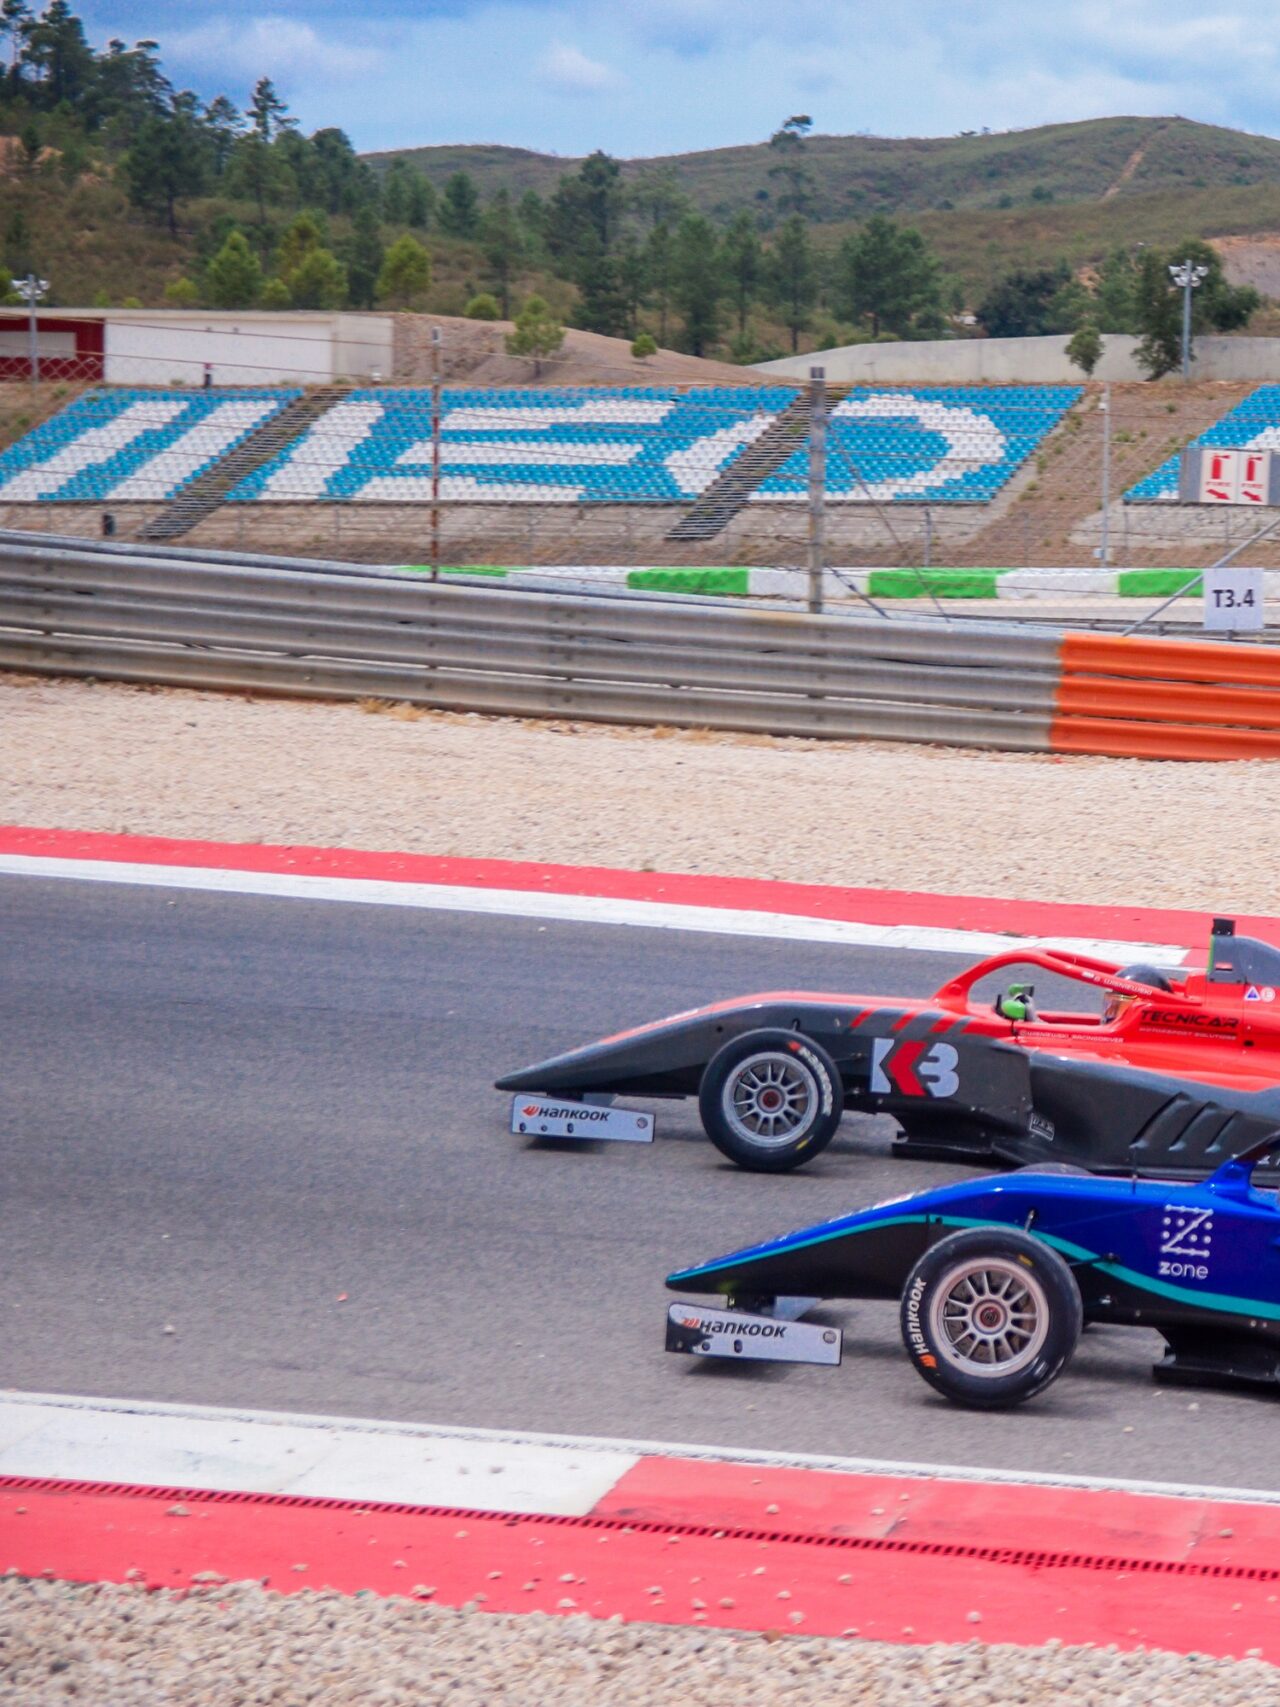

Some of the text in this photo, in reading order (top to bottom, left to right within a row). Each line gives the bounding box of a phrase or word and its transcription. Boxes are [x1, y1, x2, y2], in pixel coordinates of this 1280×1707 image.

[1212, 589, 1255, 608] T3.4
[1141, 1010, 1240, 1028] TECNICAR
[1159, 1261, 1209, 1279] zone
